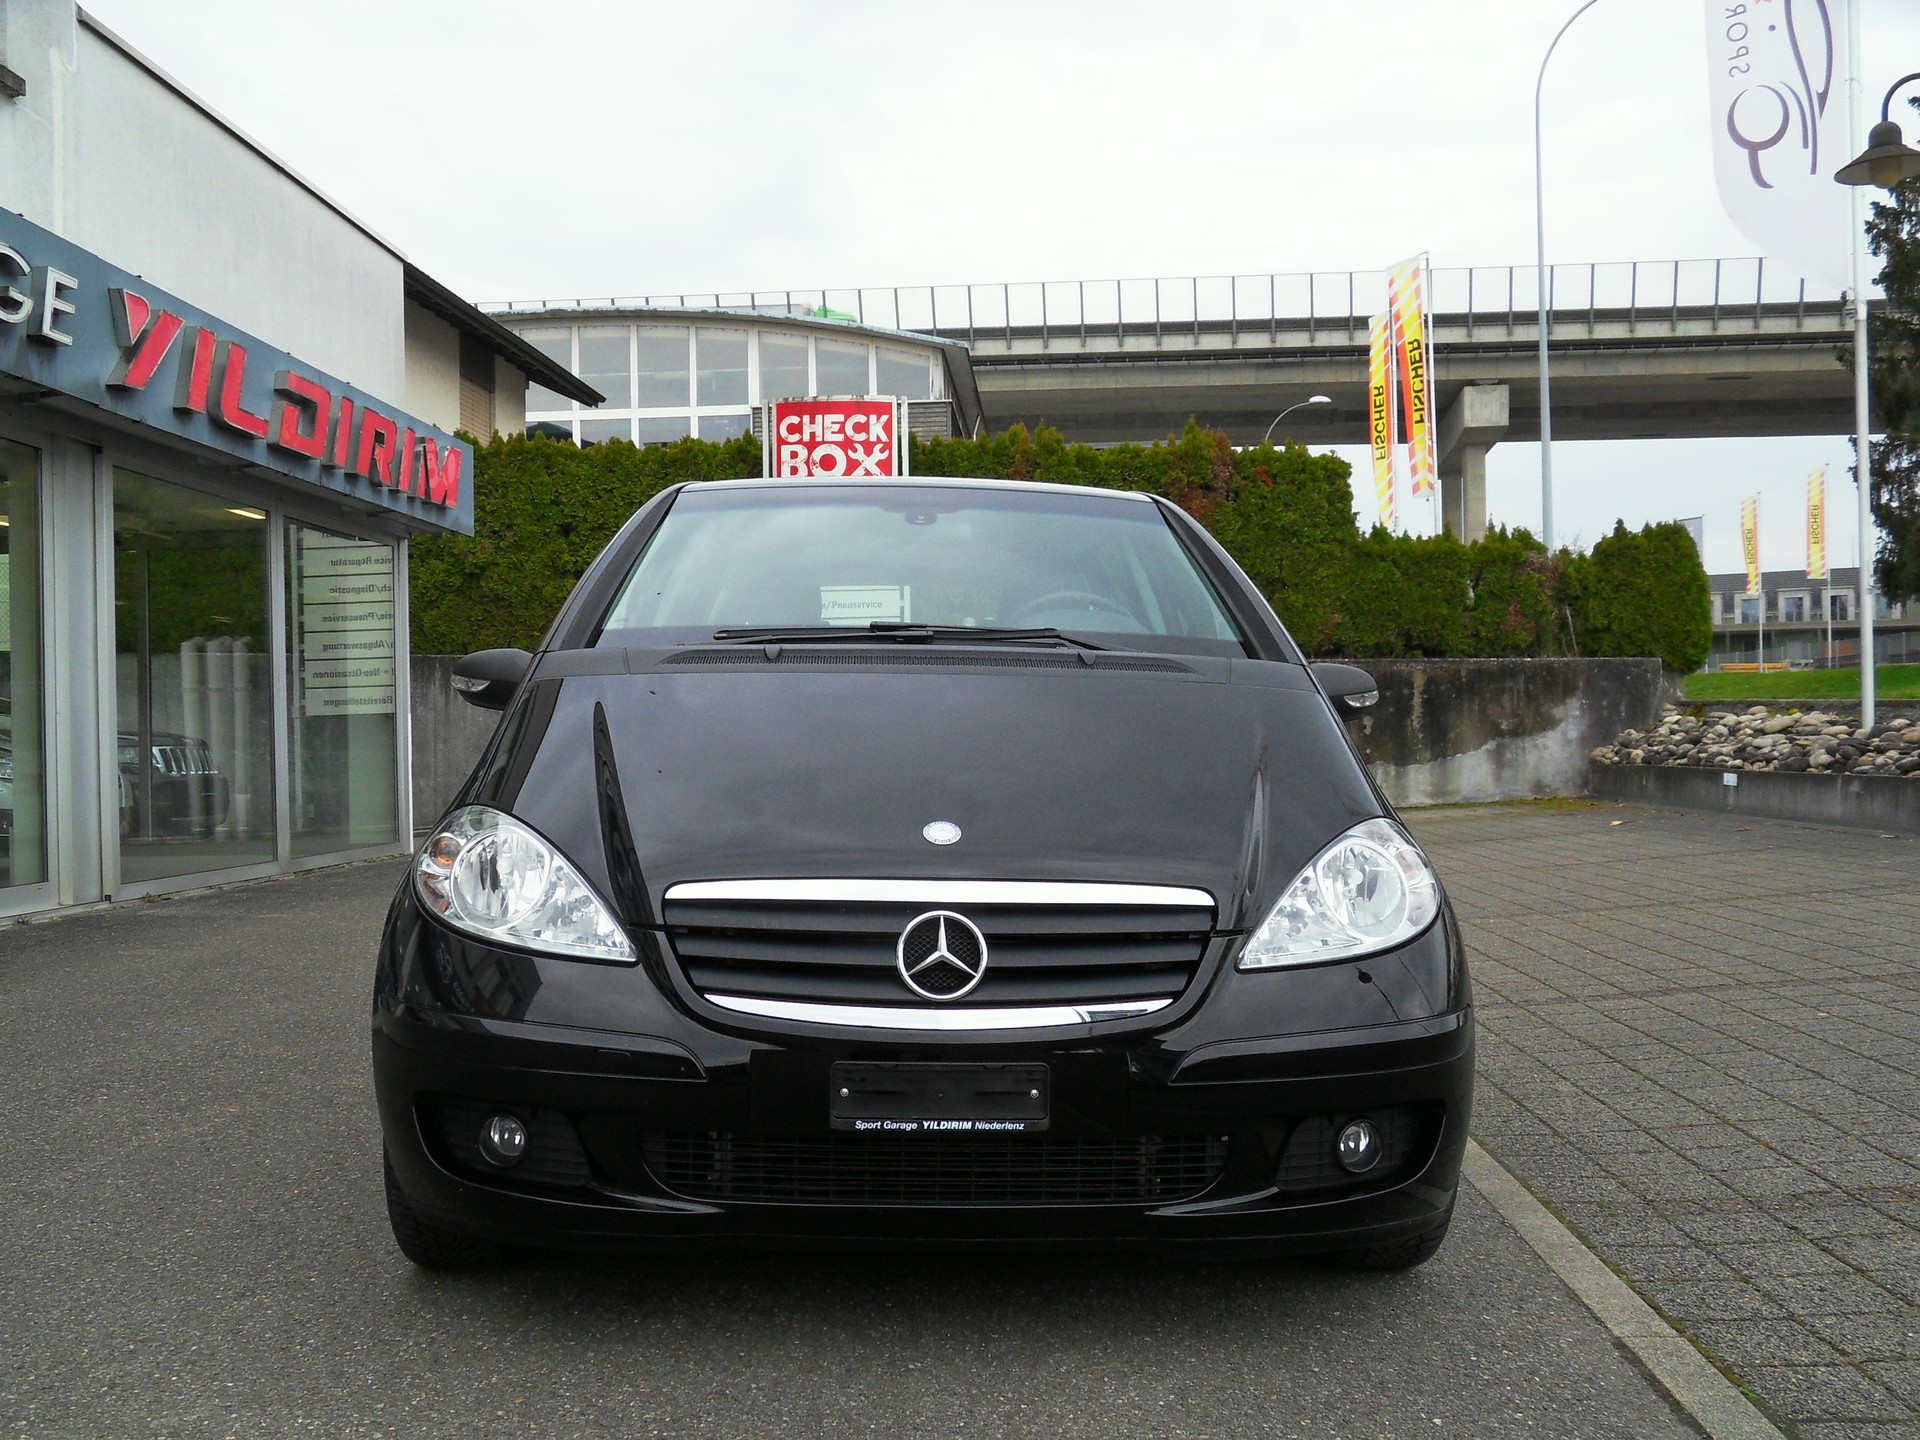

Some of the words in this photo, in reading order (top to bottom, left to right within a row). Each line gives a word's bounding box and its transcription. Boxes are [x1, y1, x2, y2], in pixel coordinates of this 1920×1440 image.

[108, 287, 462, 508] YILDIRIM
[779, 413, 890, 443] CHECK
[855, 1120, 882, 1130] Sport
[883, 1120, 918, 1131] Garage
[922, 1120, 972, 1130] YILDIRIM
[974, 1120, 1025, 1130] Niederlenz
